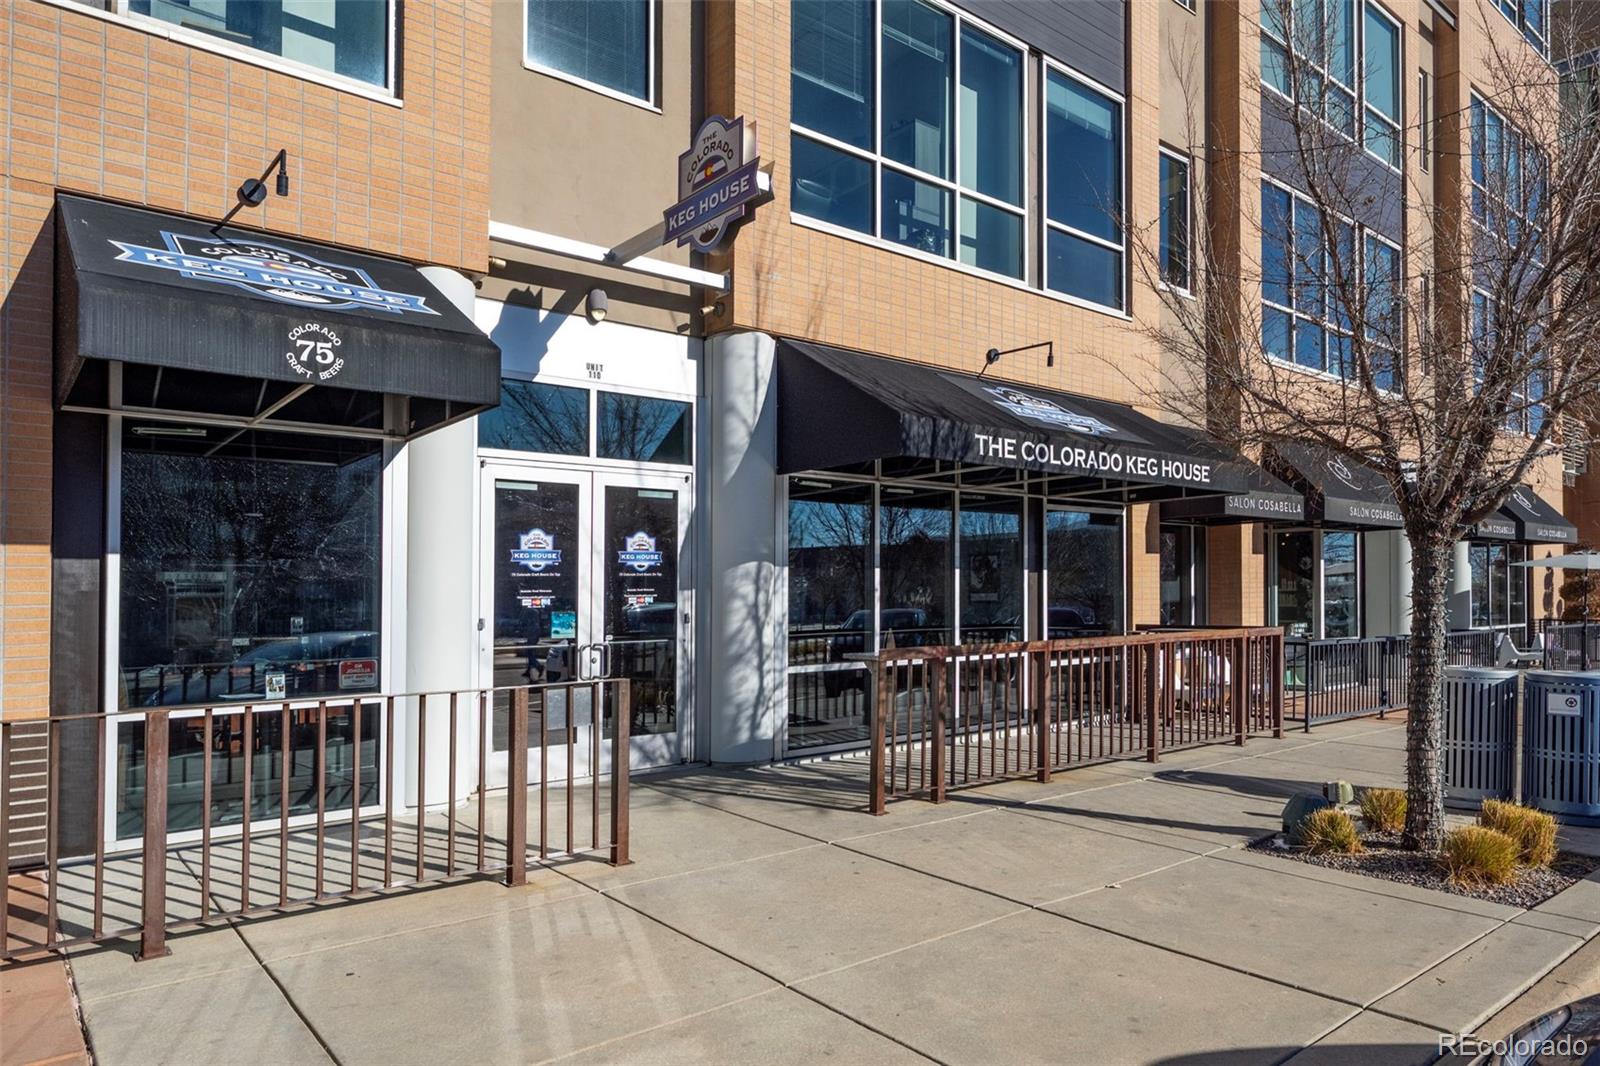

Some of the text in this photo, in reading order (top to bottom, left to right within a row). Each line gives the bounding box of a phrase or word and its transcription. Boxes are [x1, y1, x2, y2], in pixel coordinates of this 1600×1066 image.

[702, 130, 718, 144] THE
[686, 140, 734, 183] COLORADO
[669, 174, 750, 231] KEG HOUSE
[201, 247, 347, 279] COLORADO
[145, 252, 410, 306] KEG HOUSE
[288, 323, 341, 346] COLORADO
[296, 339, 334, 364] 75
[286, 352, 344, 380] CRAFT BEERS
[586, 362, 603, 372] UNIT
[588, 370, 601, 380] 110
[974, 433, 1210, 483] THE COLORADO KEG HOUSE
[1229, 496, 1302, 513] SALON COSABELLA
[1349, 506, 1403, 521] SALON COSABELLA
[1493, 525, 1515, 535] COSABELLA
